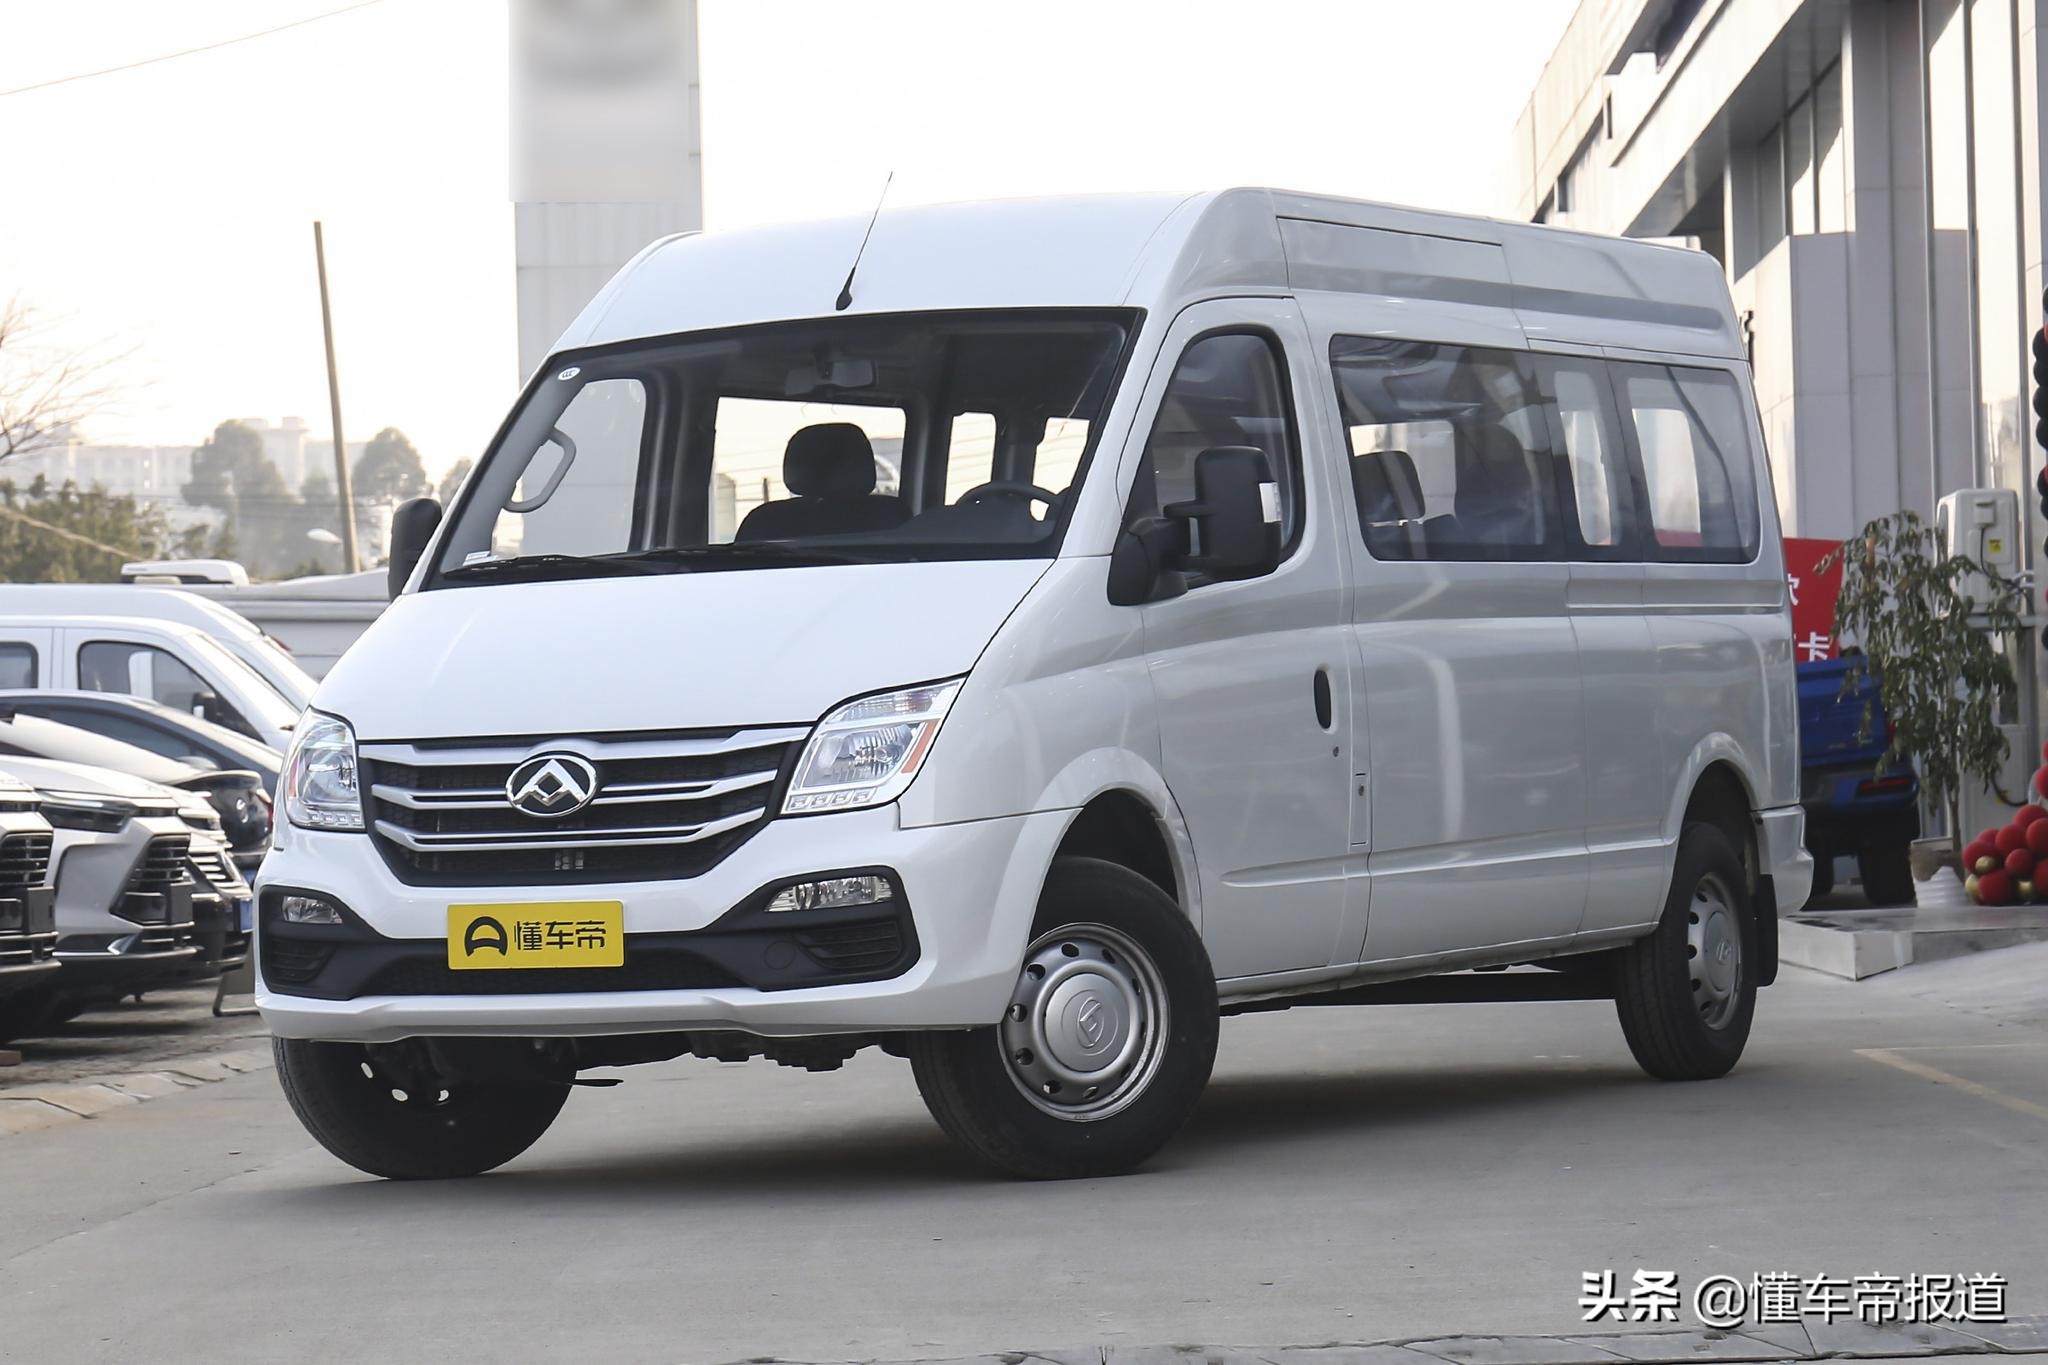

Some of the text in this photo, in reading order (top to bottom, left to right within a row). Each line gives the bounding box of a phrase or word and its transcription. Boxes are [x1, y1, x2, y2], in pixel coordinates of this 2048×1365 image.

[1794, 631, 1830, 662] 卡
[514, 920, 606, 950] 懂车帝
